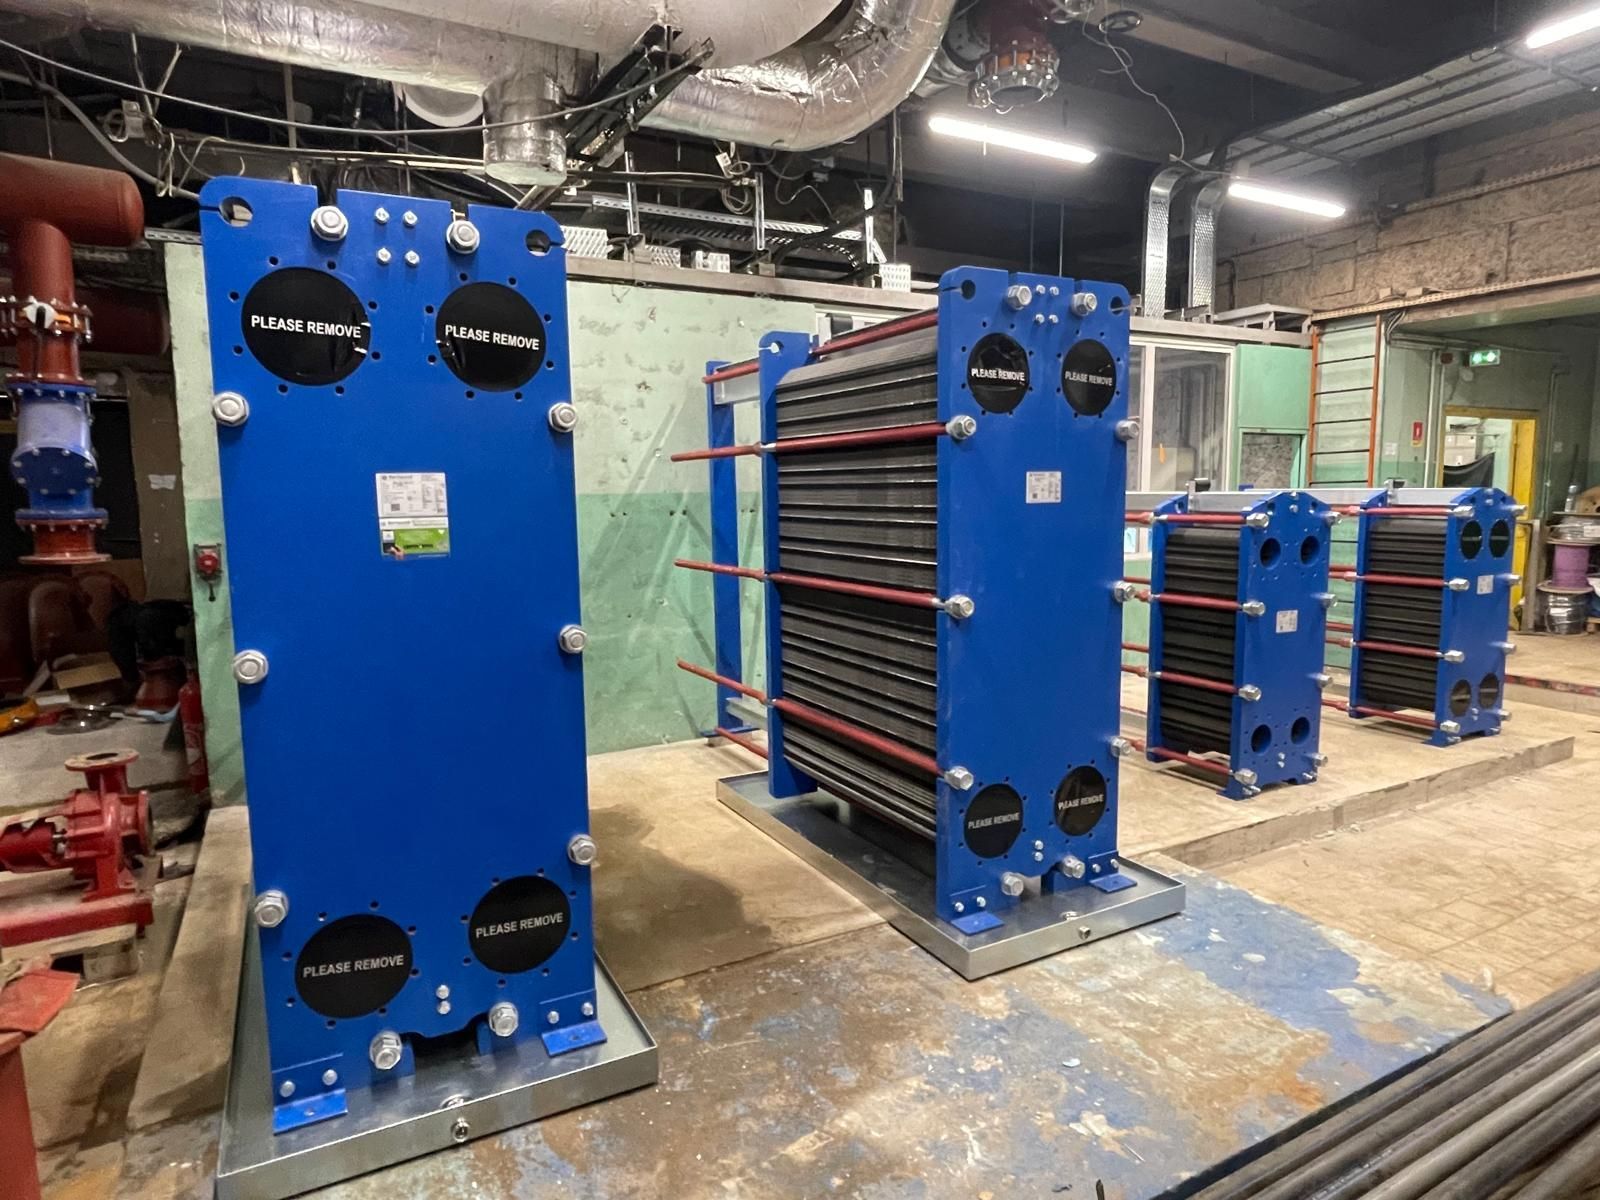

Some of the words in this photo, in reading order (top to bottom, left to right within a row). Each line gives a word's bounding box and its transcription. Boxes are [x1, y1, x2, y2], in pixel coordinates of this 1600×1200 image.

[251, 315, 304, 332] PLEASE
[307, 321, 361, 338] REMOVE
[445, 324, 490, 342] PLEASE
[493, 332, 539, 350] REMOVE
[971, 368, 997, 379] PLEASE
[998, 370, 1025, 381] REMOVE
[1065, 371, 1088, 382] PLEASE
[1058, 799, 1080, 810] PLEASE
[968, 818, 993, 829] PLEASE
[475, 921, 518, 938] PLEASE
[520, 913, 563, 930] REMOVE
[303, 962, 351, 978] PLEASE
[354, 955, 404, 971] REMOVE
